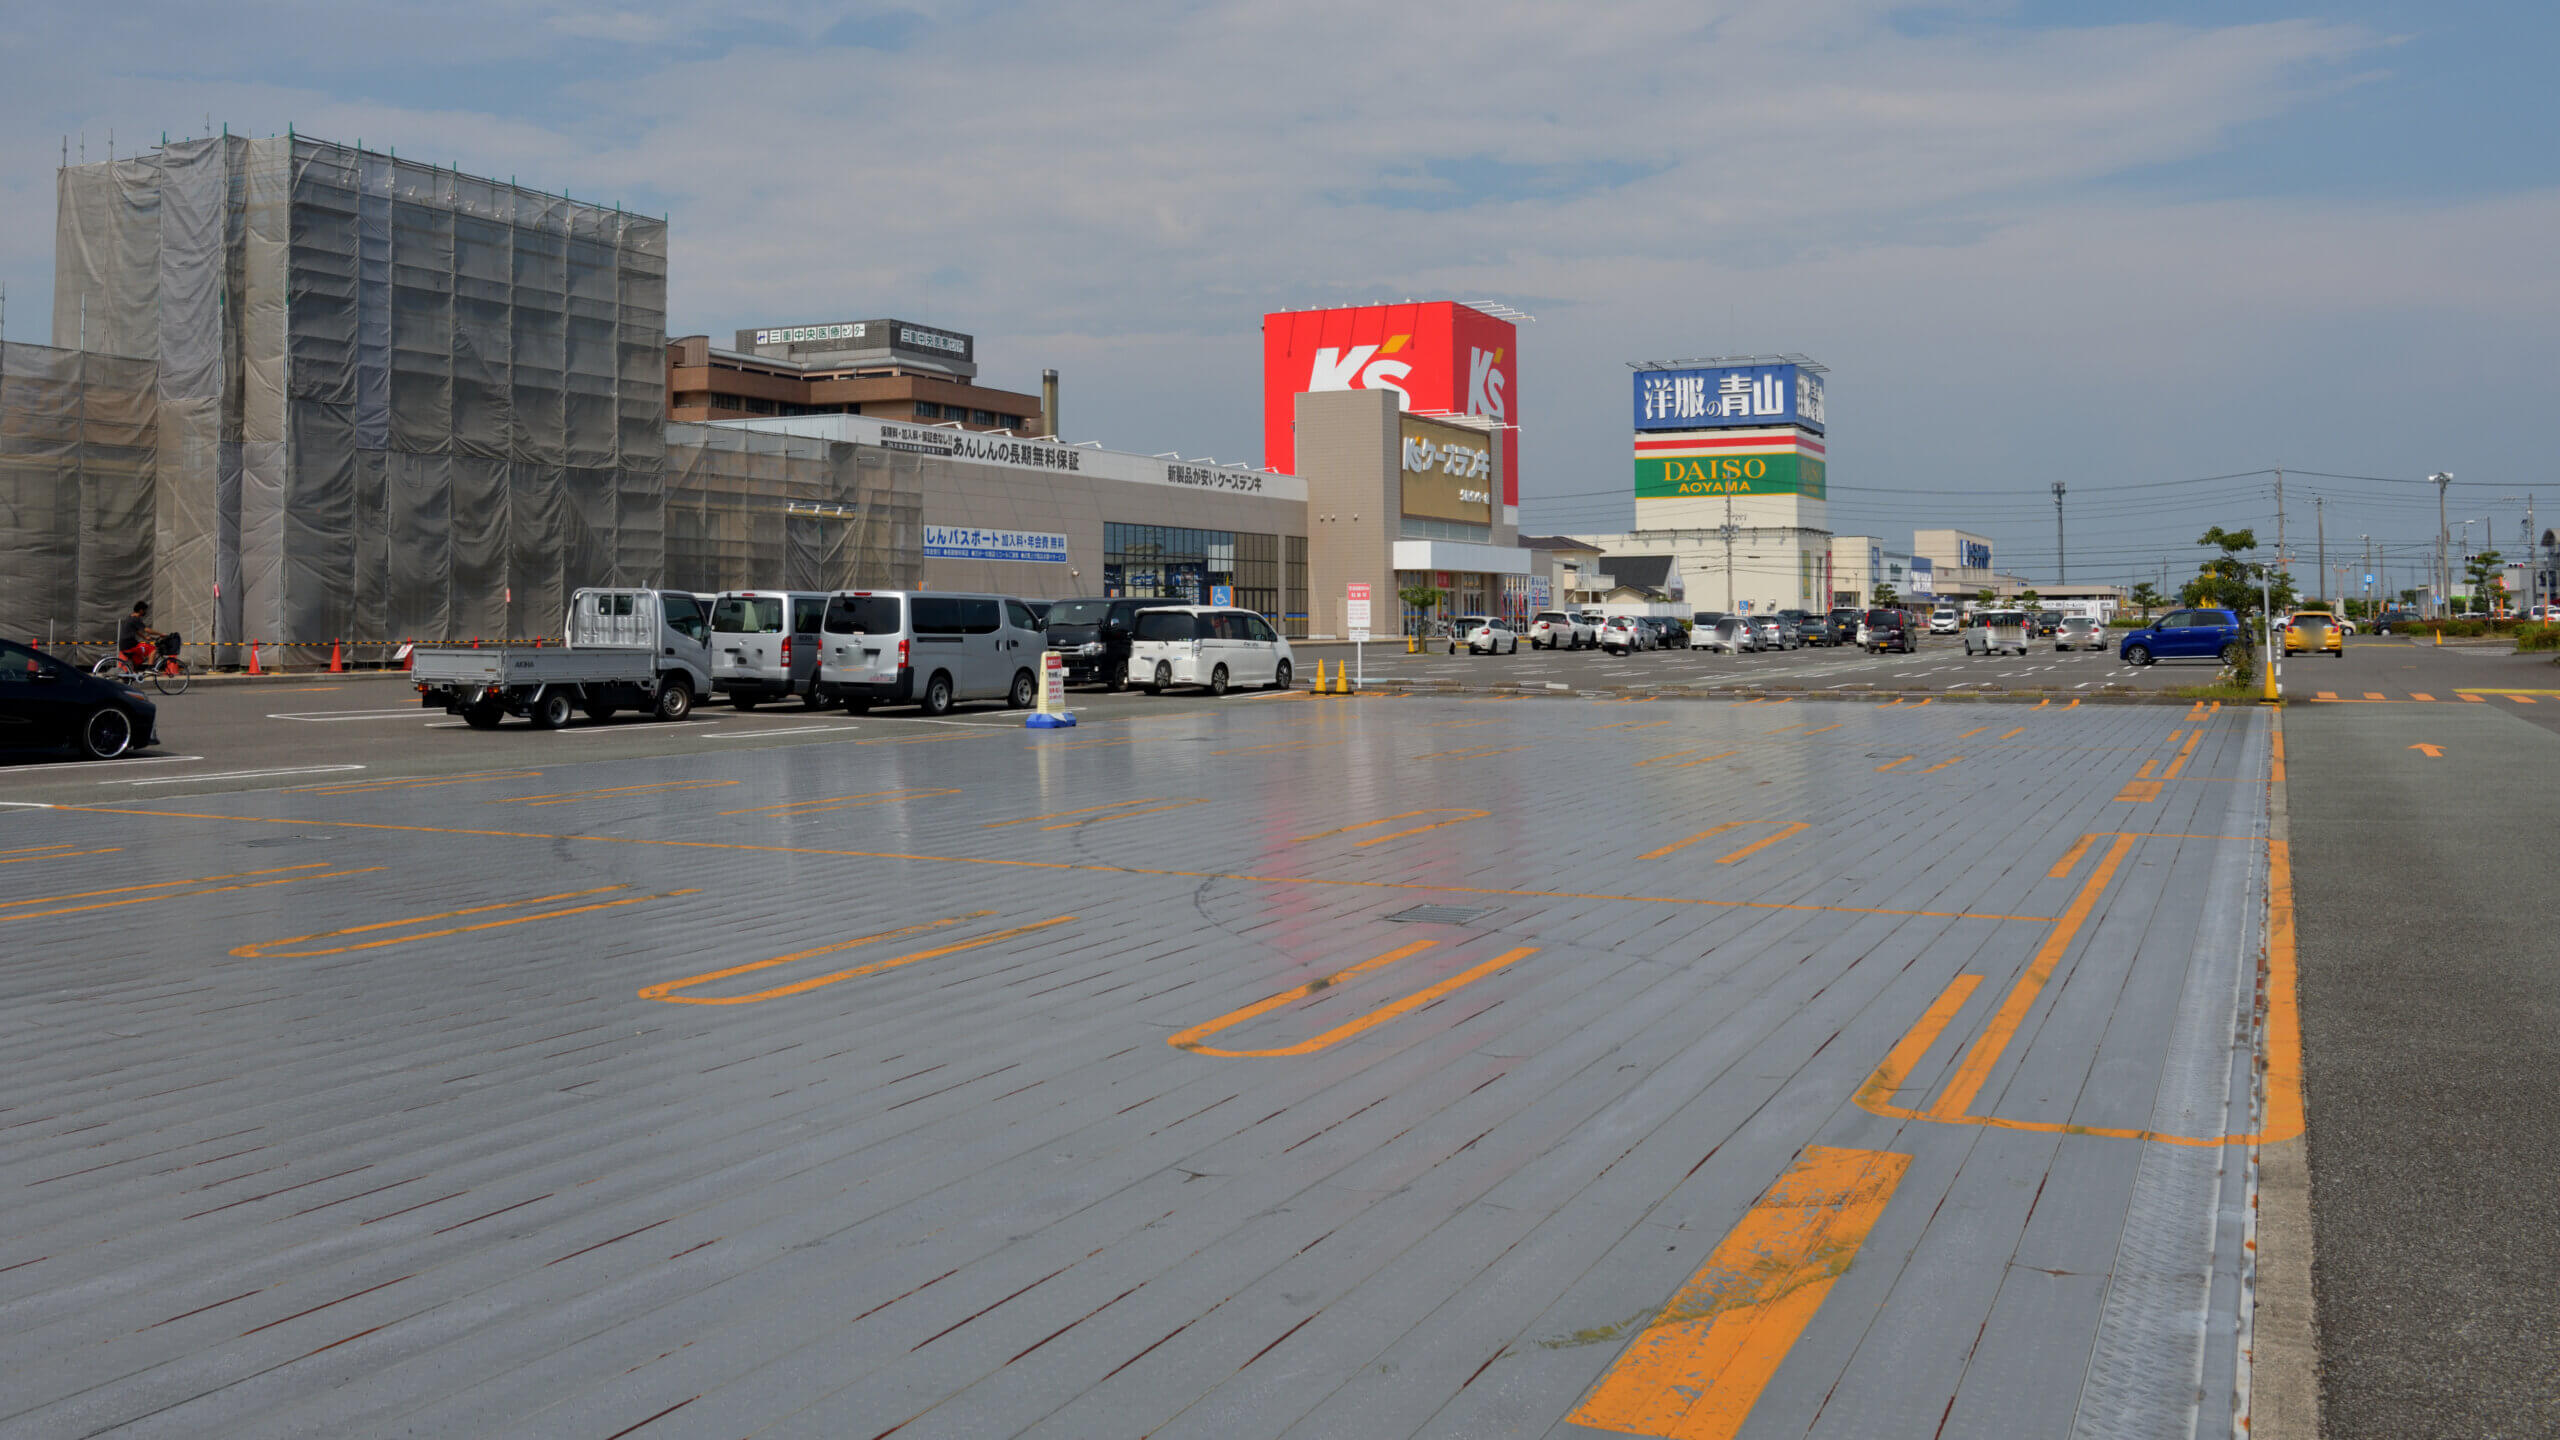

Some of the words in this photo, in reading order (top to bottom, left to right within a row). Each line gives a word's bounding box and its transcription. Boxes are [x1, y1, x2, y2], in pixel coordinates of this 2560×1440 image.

[770, 324, 865, 342] 三重中央医療センター
[1644, 373, 1784, 420] 洋服の青山
[953, 437, 1080, 471] あんしんの長期無料保証
[1664, 458, 1766, 481] DAISO
[1678, 481, 1751, 493] AOYAMA
